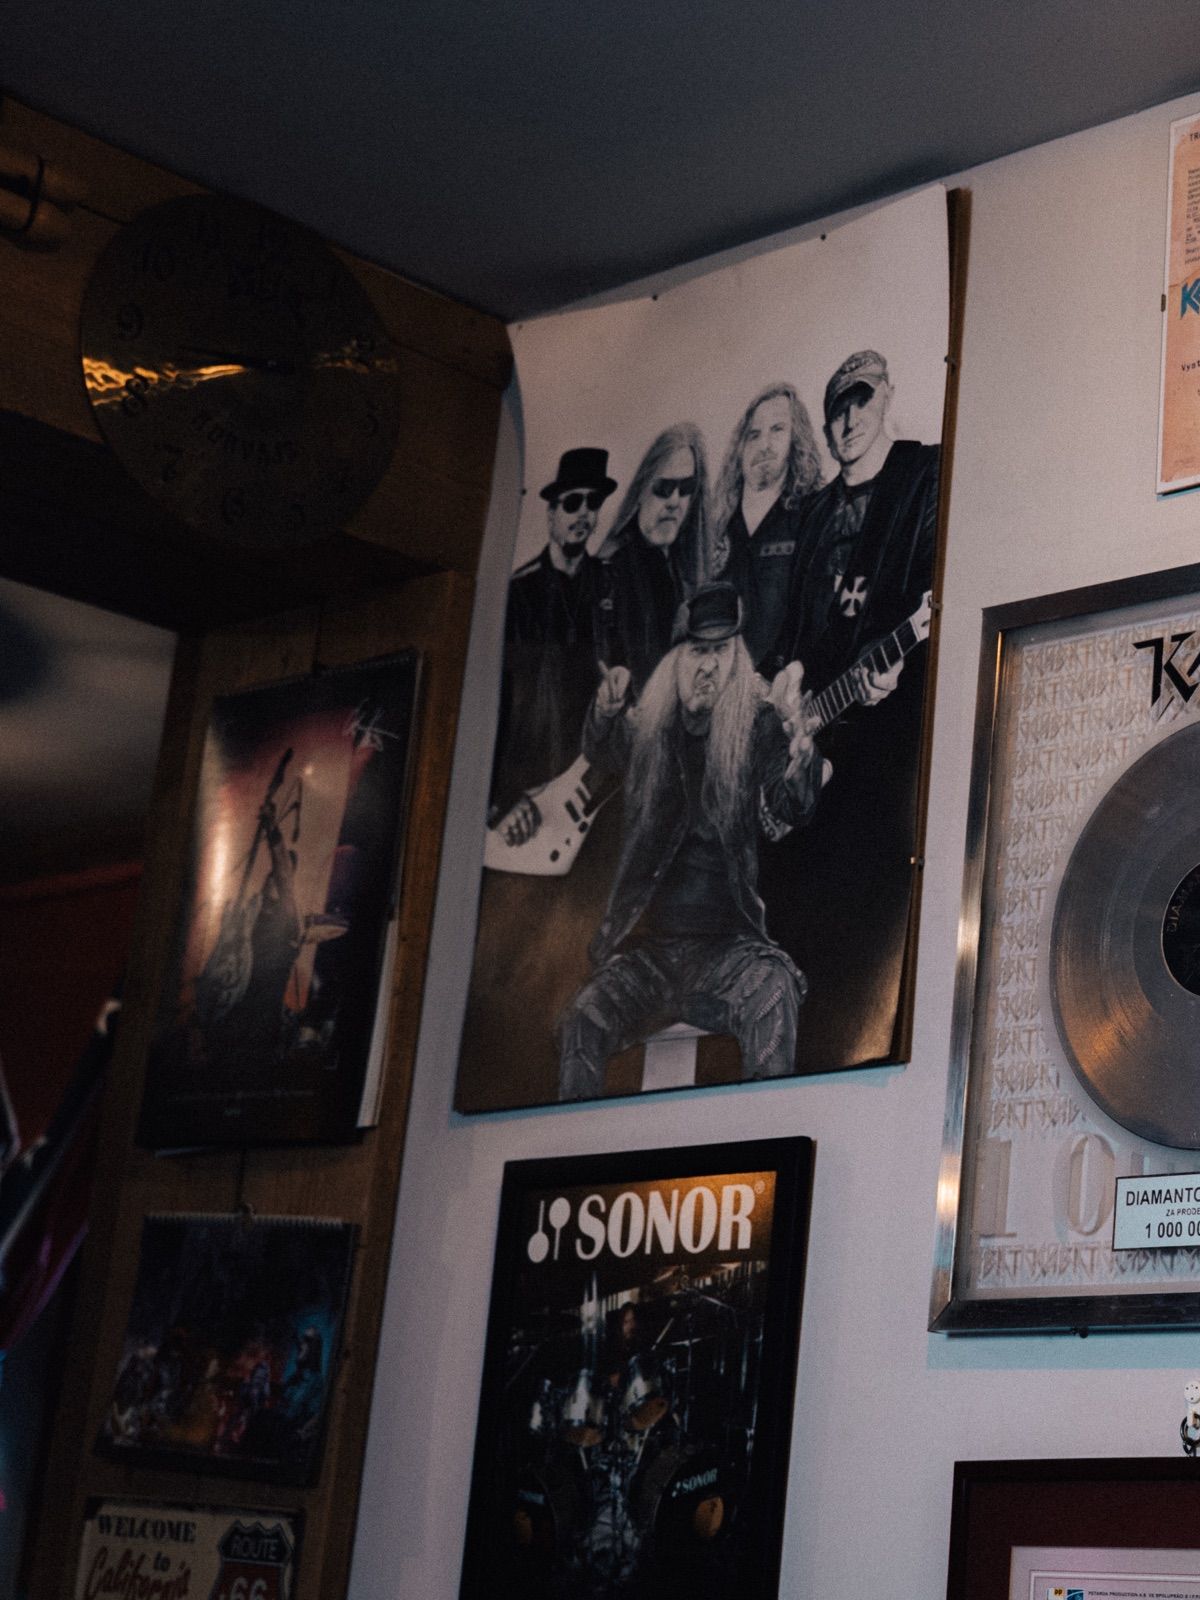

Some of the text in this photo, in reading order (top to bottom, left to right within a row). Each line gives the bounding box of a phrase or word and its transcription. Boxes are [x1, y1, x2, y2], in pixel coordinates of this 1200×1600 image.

[575, 1183, 756, 1261] SONOR
[1166, 1209, 1175, 1217] ZA
[1145, 1222, 1151, 1239] 1
[1157, 1221, 1183, 1239] 000
[682, 1467, 718, 1492] SONOR
[97, 1514, 197, 1543] WELCOME
[231, 1535, 279, 1560] ROUTE
[153, 1550, 171, 1573] to
[229, 1576, 269, 1600] 66
